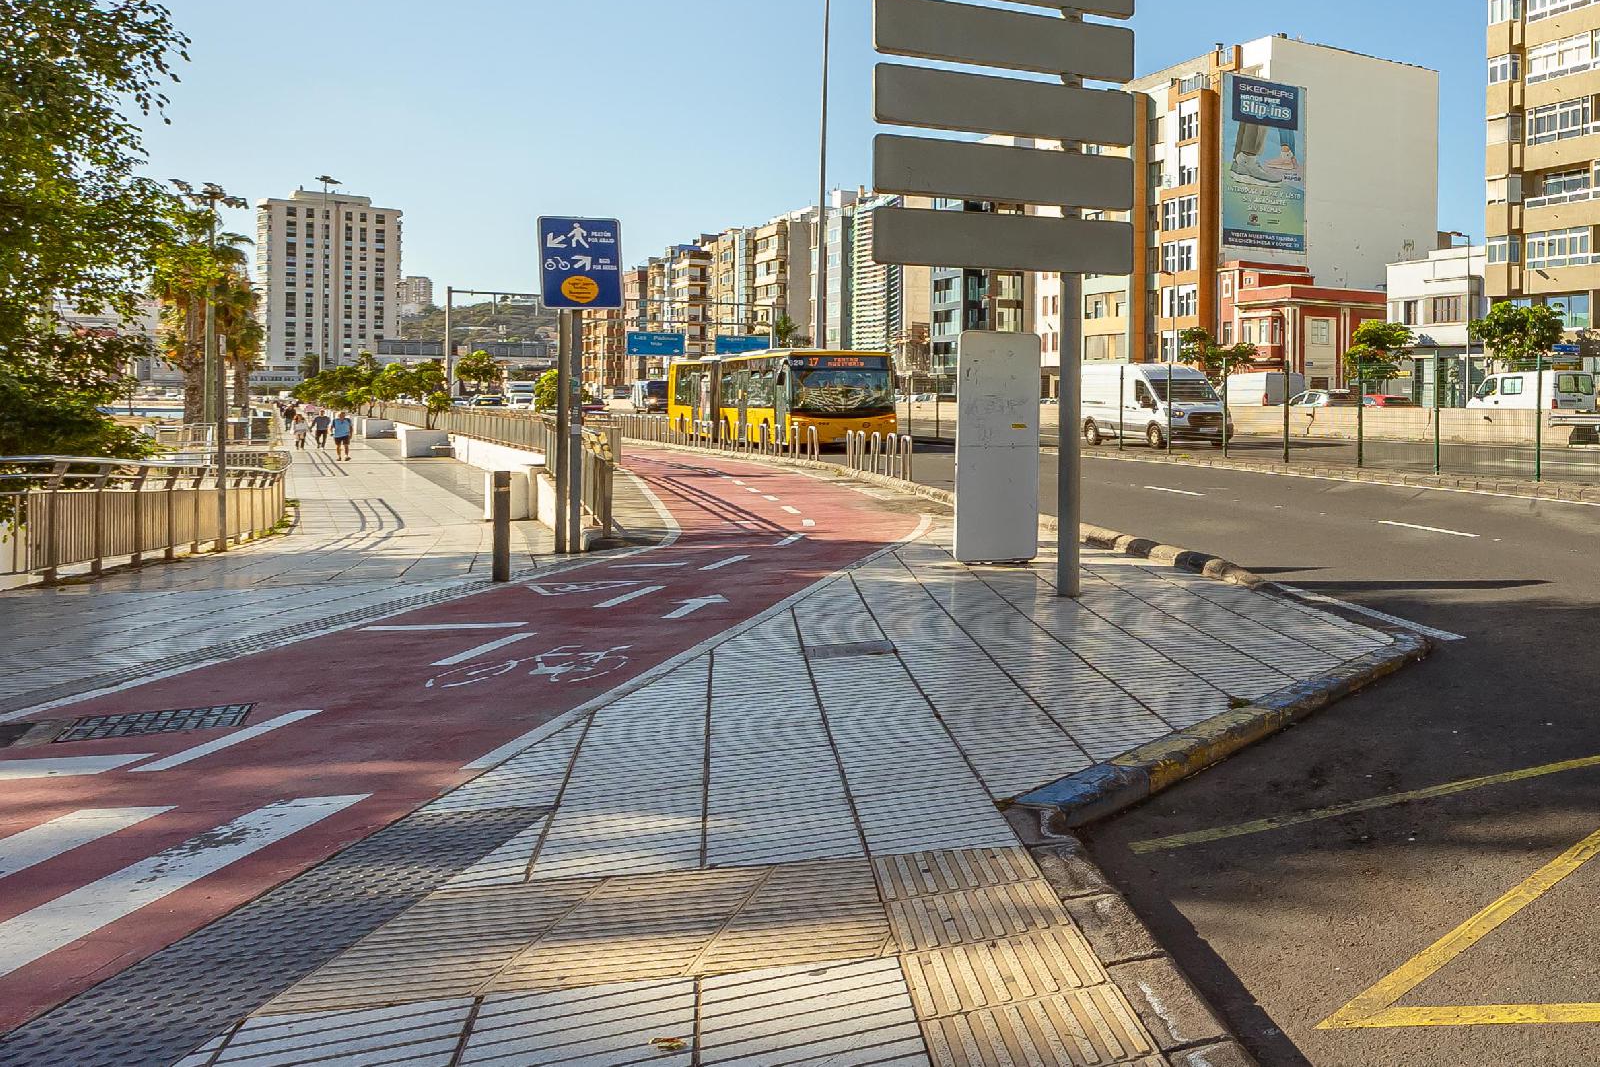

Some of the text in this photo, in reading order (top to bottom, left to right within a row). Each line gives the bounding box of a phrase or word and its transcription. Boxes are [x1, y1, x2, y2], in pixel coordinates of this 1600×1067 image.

[1239, 83, 1294, 99] SKECHERS
[1240, 94, 1263, 102] HANDS
[1242, 100, 1290, 119] Slip-ins
[808, 357, 819, 366] 17
